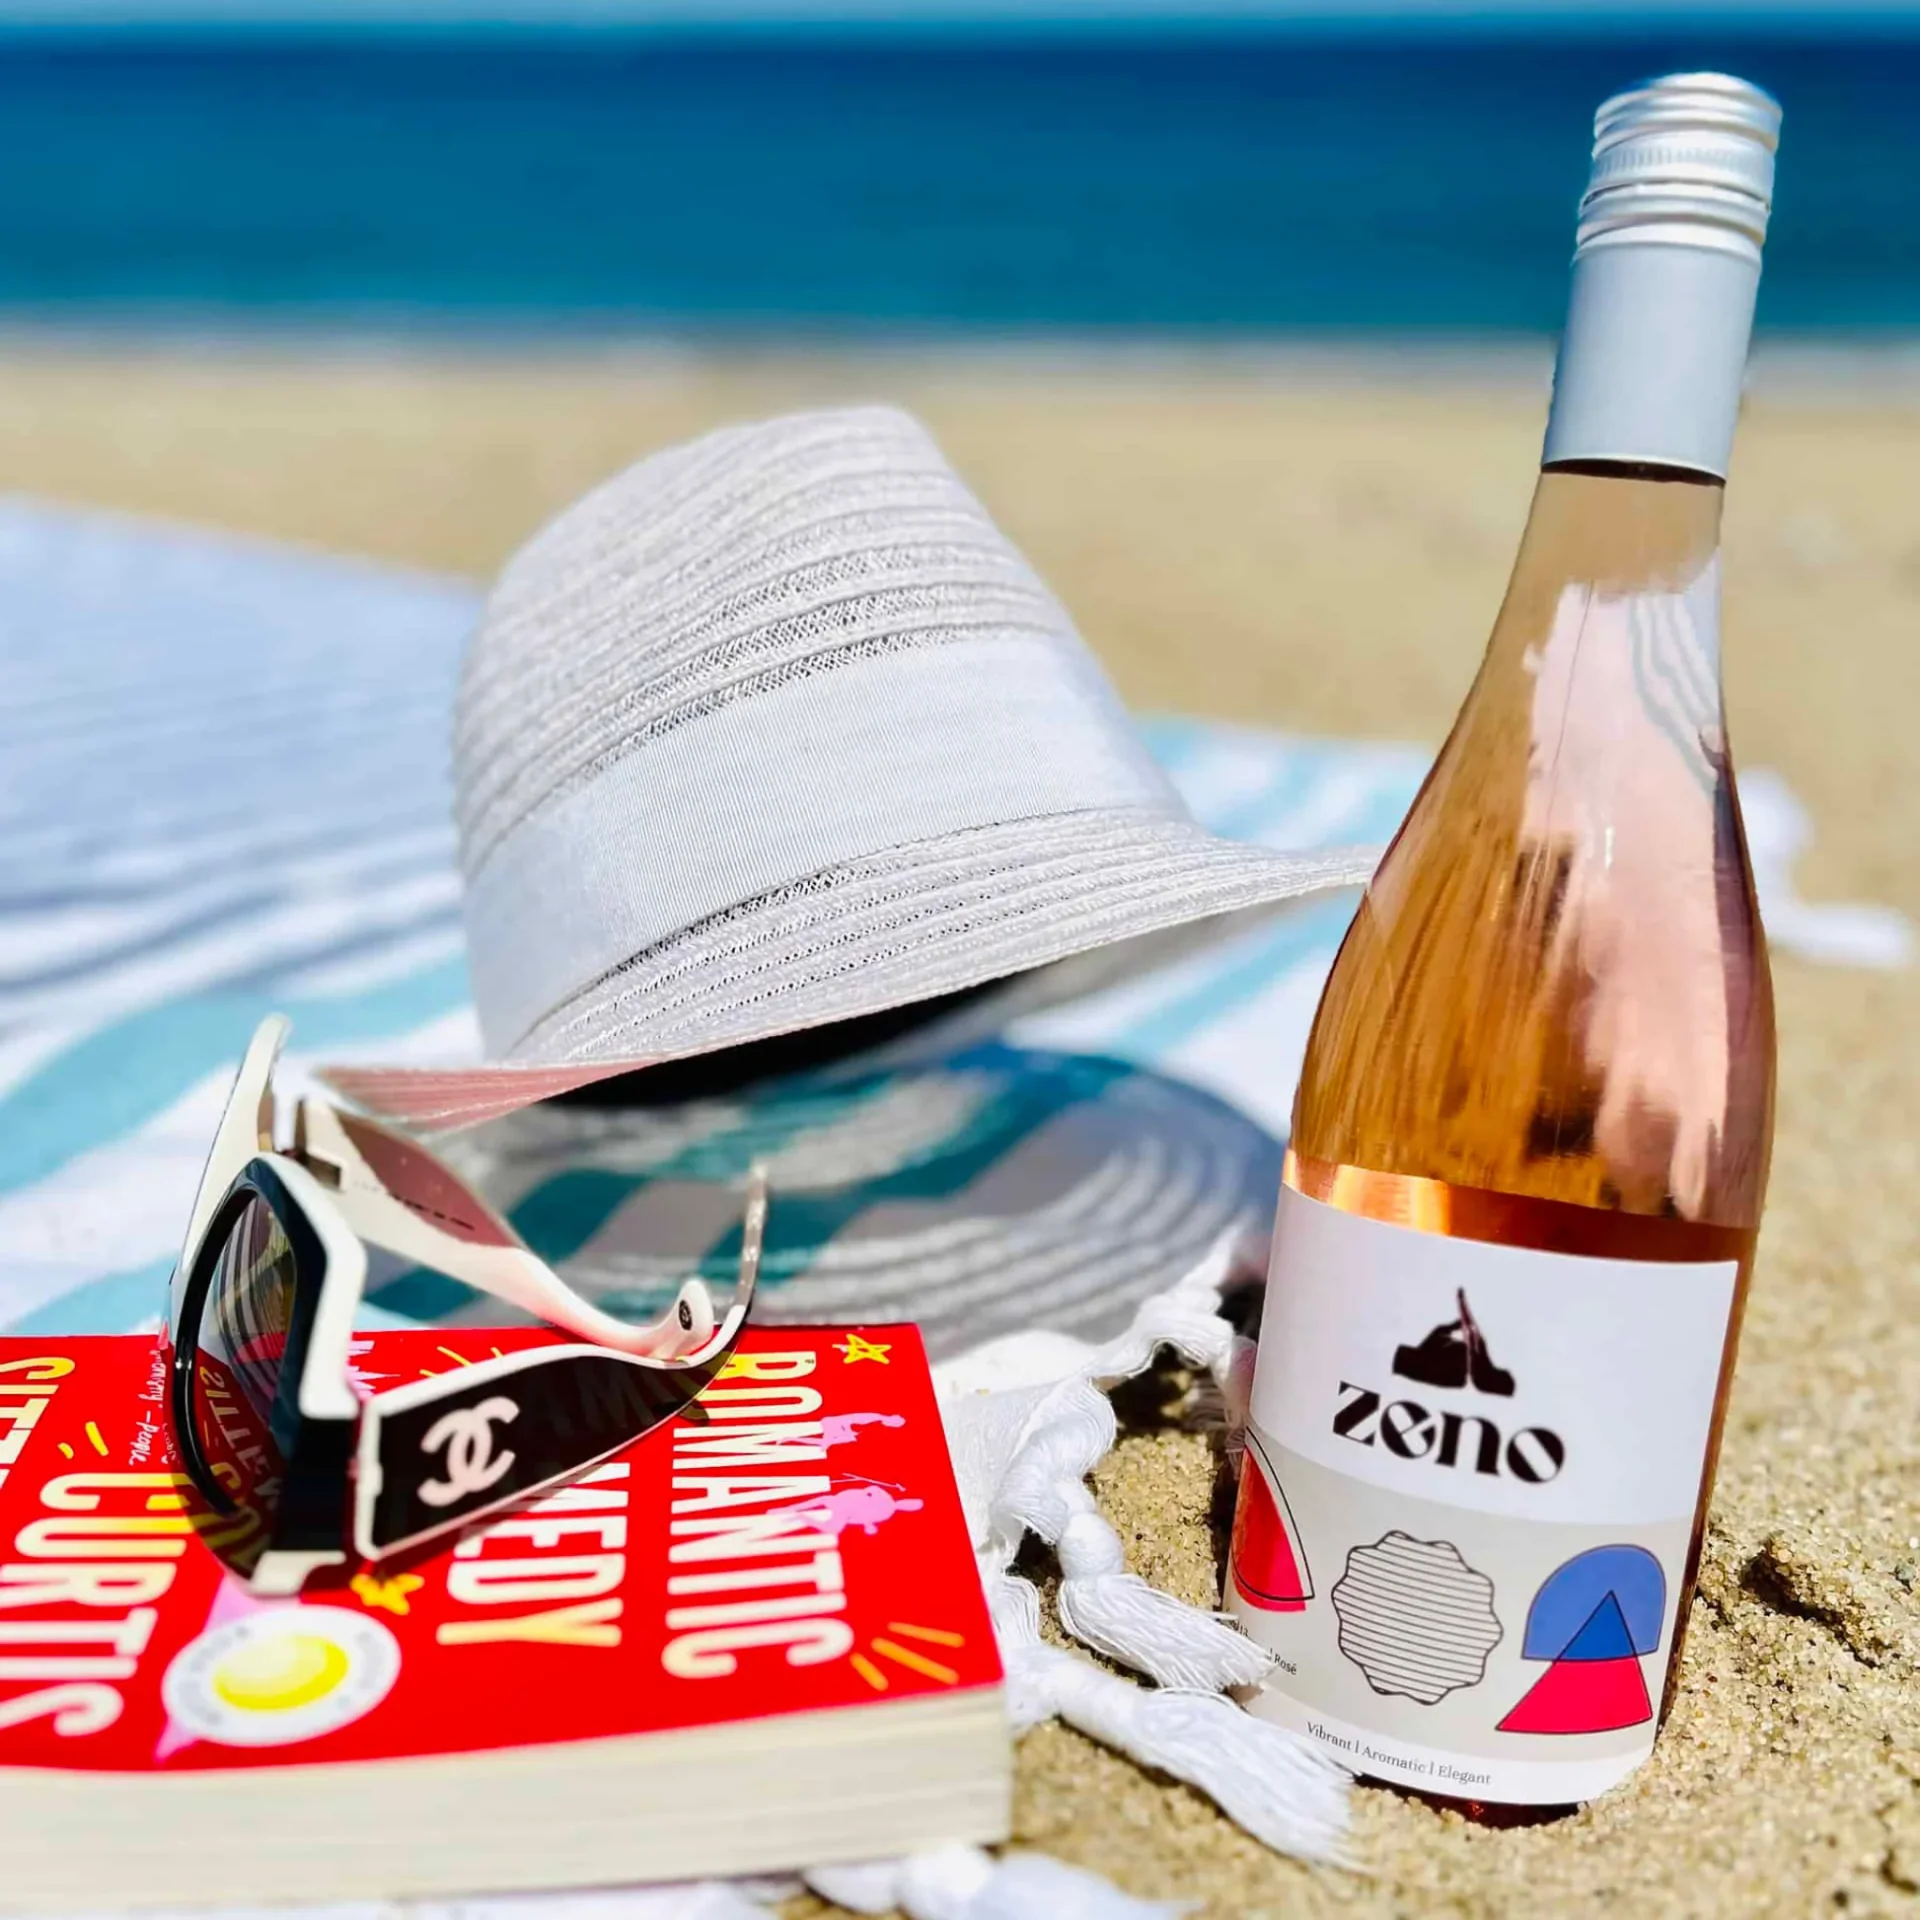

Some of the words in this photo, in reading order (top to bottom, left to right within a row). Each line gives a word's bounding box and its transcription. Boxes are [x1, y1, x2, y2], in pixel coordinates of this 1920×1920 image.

[1332, 1379, 1567, 1484] zeno
[660, 1350, 855, 1679] ROMANTIC
[1306, 1720, 1352, 1751] Vibrant
[1361, 1745, 1427, 1774] Aromatic
[1437, 1764, 1492, 1786] Elegant
